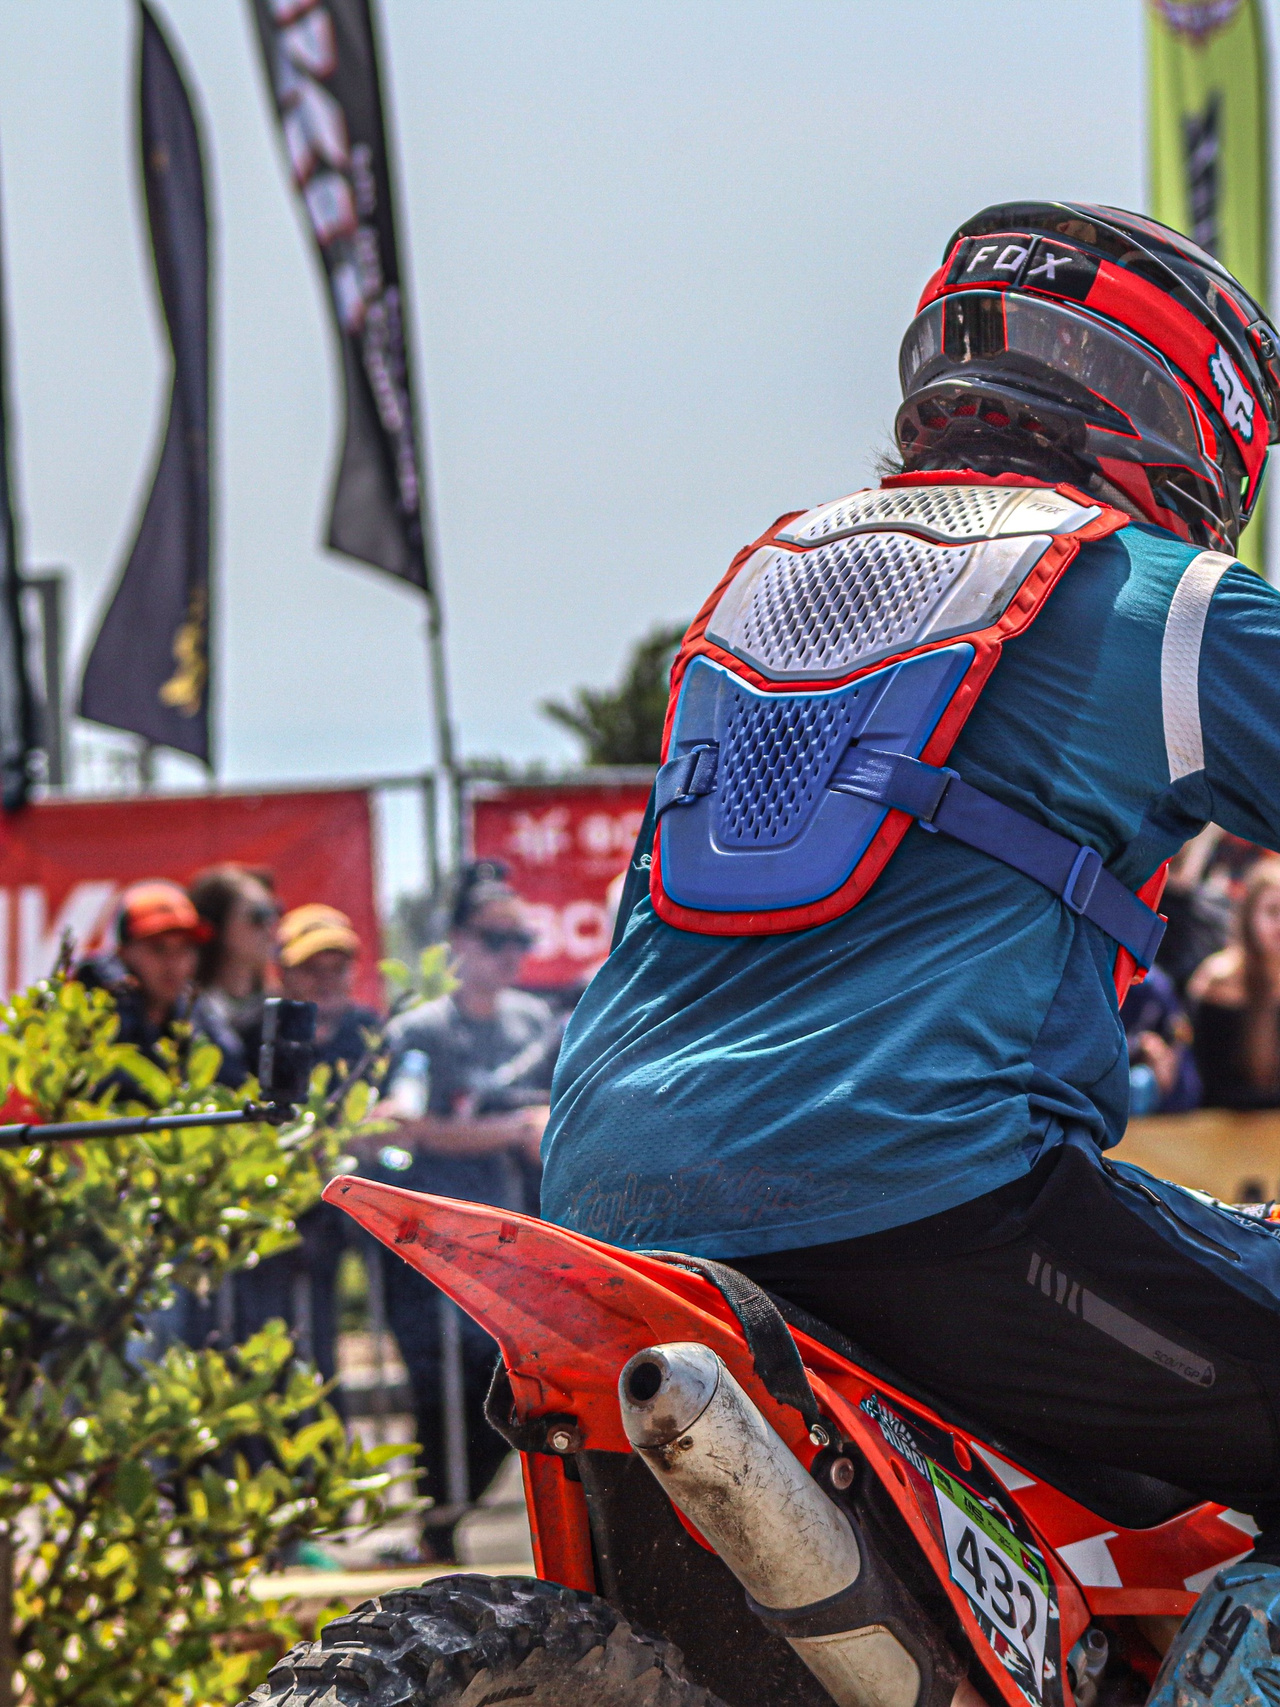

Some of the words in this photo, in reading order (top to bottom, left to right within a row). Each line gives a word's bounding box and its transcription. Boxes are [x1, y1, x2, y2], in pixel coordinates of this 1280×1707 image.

[966, 244, 1073, 280] FOX
[1026, 502, 1067, 515] FOX
[956, 1525, 1037, 1673] 432
